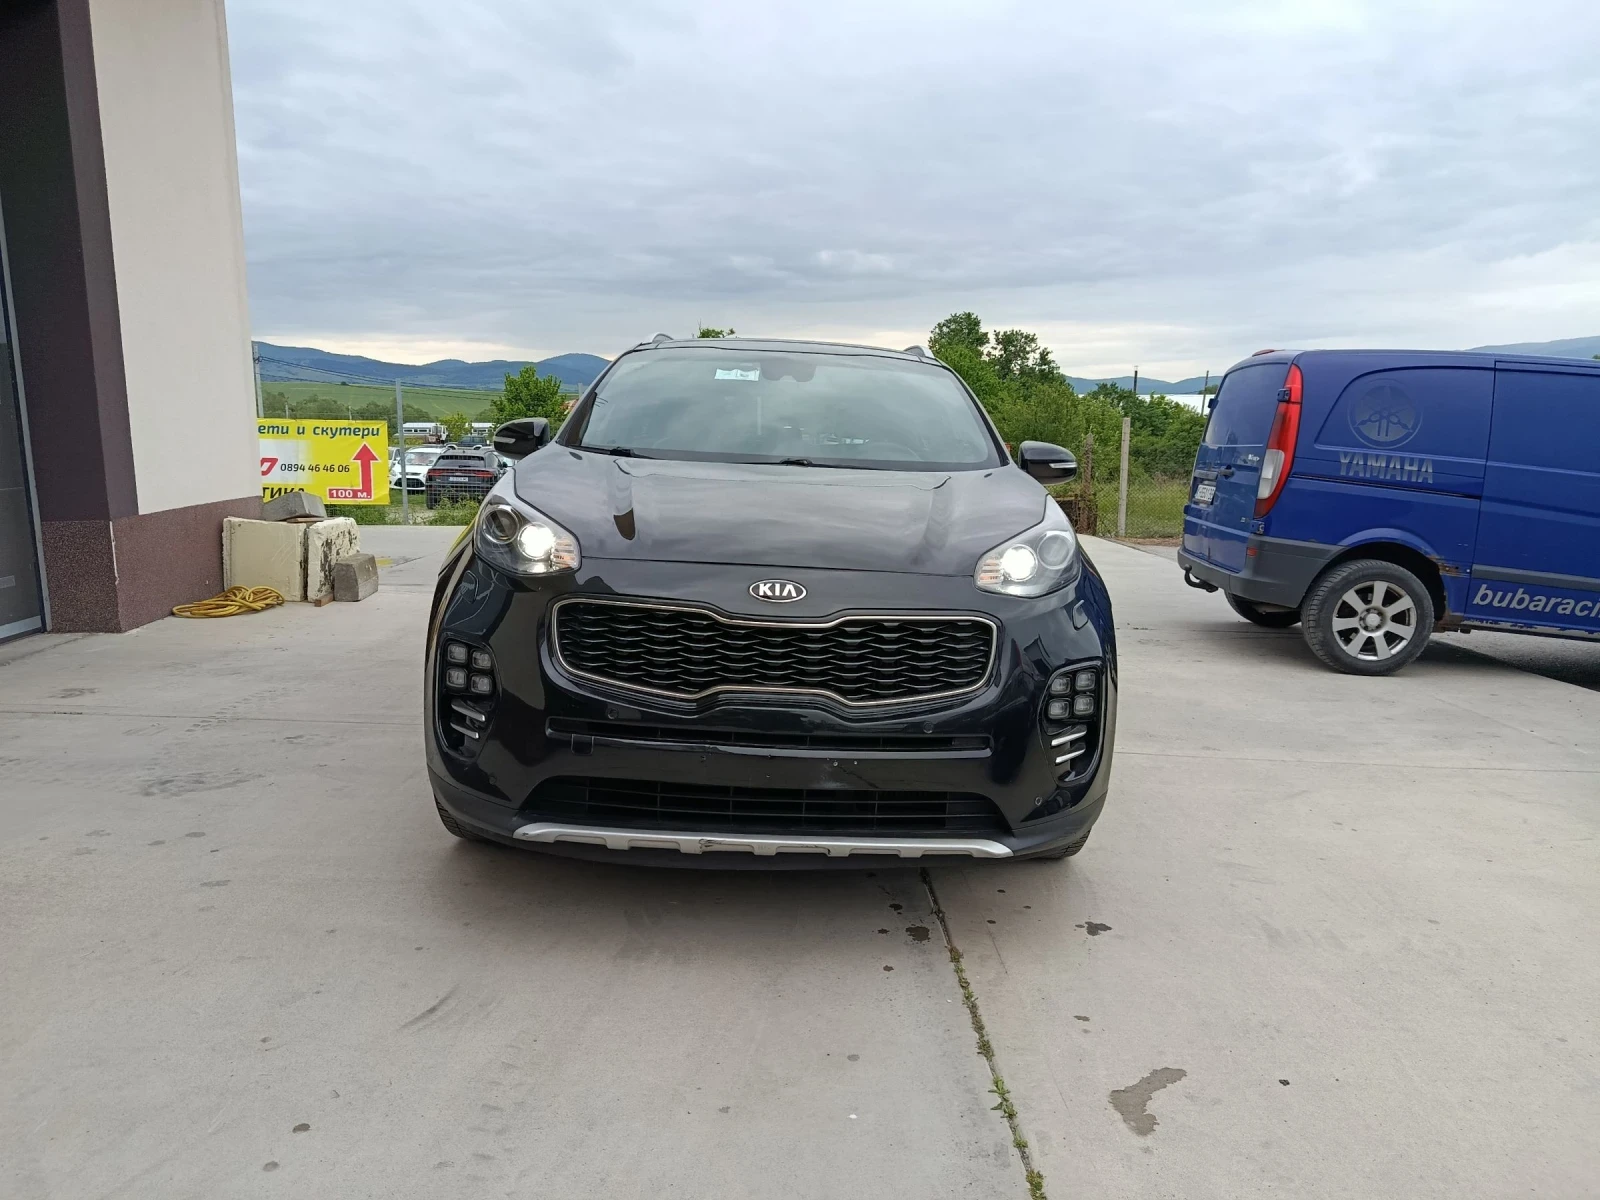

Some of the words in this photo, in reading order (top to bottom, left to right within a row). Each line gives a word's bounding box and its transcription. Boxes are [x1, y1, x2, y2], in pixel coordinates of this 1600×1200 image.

[257, 424, 289, 435] ети
[297, 425, 306, 436] и
[312, 426, 380, 439] скутери
[280, 463, 306, 472] 0894
[308, 464, 321, 473] 46
[322, 464, 335, 473] 46
[337, 464, 350, 473] 06
[1339, 452, 1434, 484] YAMAHA
[330, 489, 354, 498] 100
[758, 582, 798, 598] KIA
